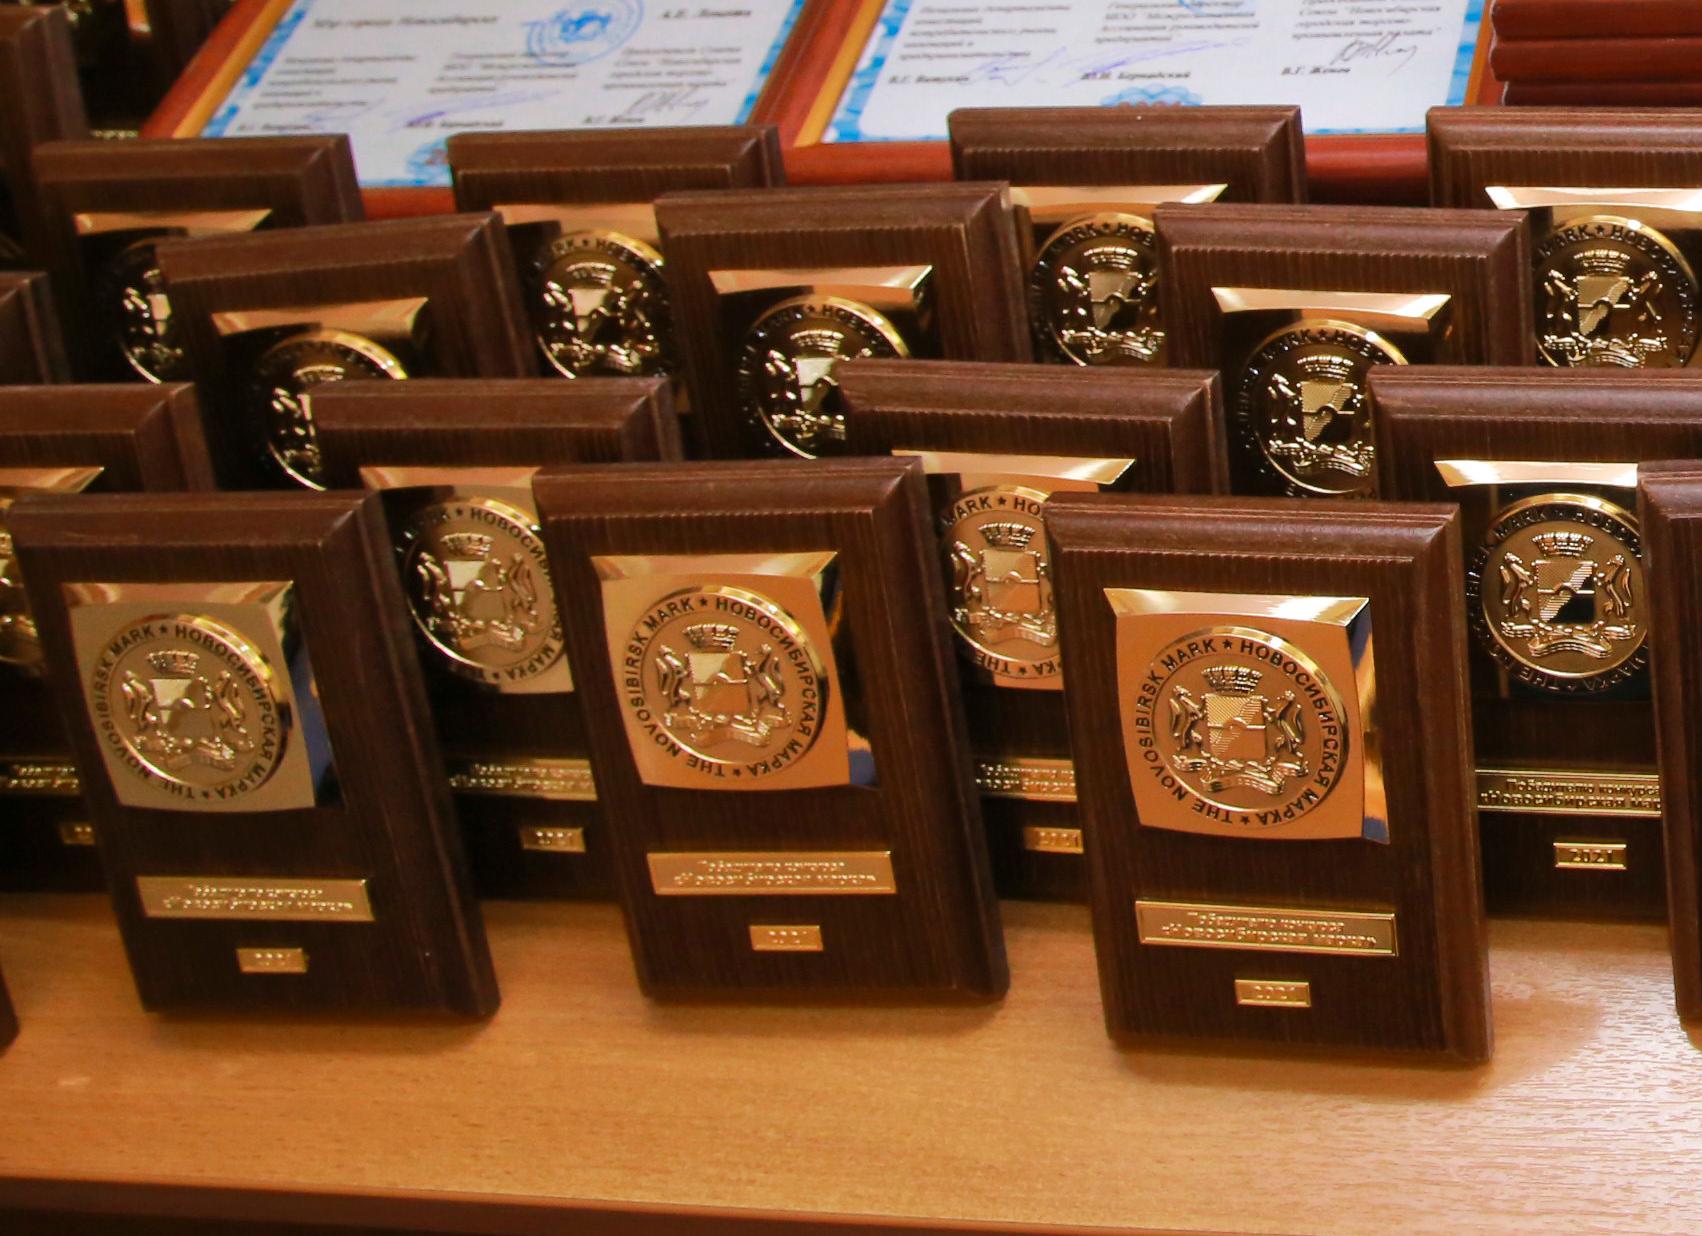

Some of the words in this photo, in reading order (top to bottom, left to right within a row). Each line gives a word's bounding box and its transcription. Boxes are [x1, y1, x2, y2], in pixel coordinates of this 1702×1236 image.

[643, 597, 694, 631] MARK
[716, 597, 817, 737] НОВОСИБИРСКАЯ
[1161, 639, 1217, 672] MARK
[625, 631, 681, 758] NOVOSIBIRSK
[1240, 639, 1340, 788] НОВОСИБИРСКАЯ
[1136, 670, 1188, 800] NOVOSIBIRSK
[687, 757, 725, 778] THE
[747, 739, 803, 777] МАРКА
[1192, 798, 1233, 824] THE
[1255, 788, 1319, 826] МАРКА
[1569, 848, 1613, 863] 2021
